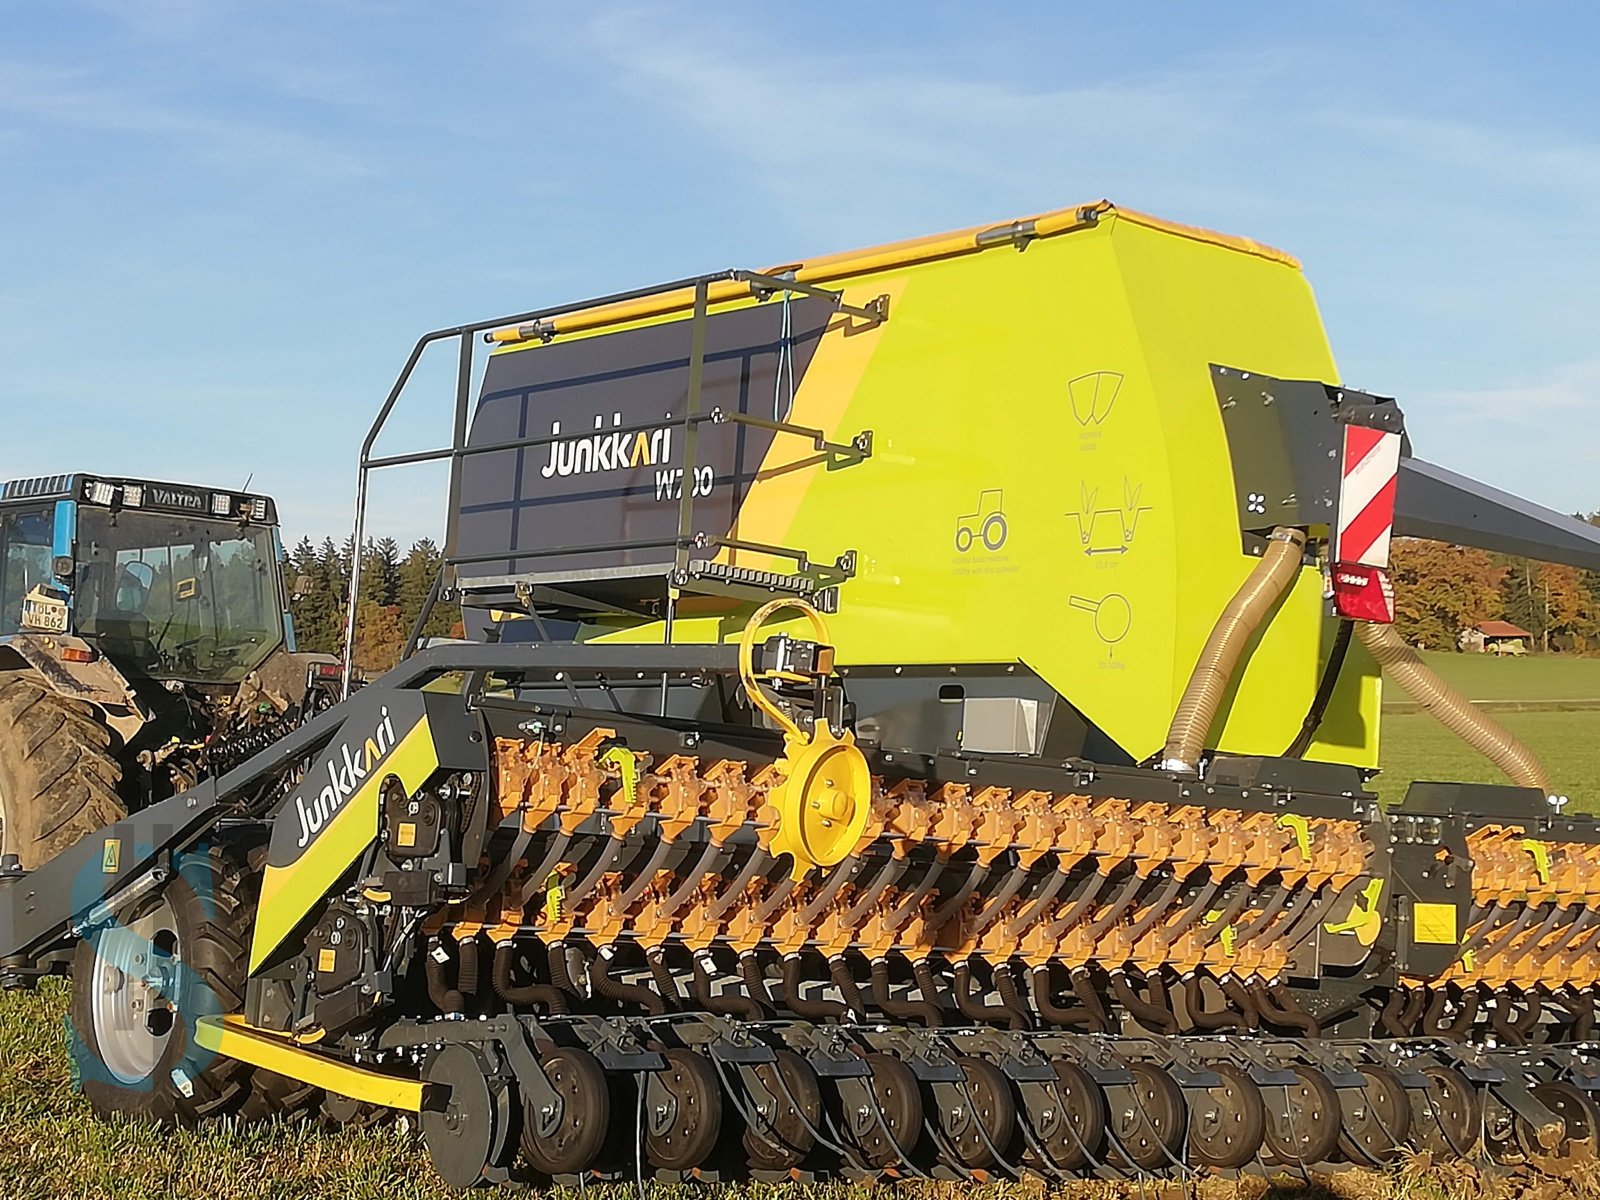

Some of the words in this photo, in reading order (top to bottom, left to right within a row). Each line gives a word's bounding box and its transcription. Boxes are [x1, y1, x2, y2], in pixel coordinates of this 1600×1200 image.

[540, 412, 673, 478] Junkkari
[152, 488, 202, 509] VALTRA
[44, 616, 63, 629] 862
[295, 705, 397, 848] Junkkari
